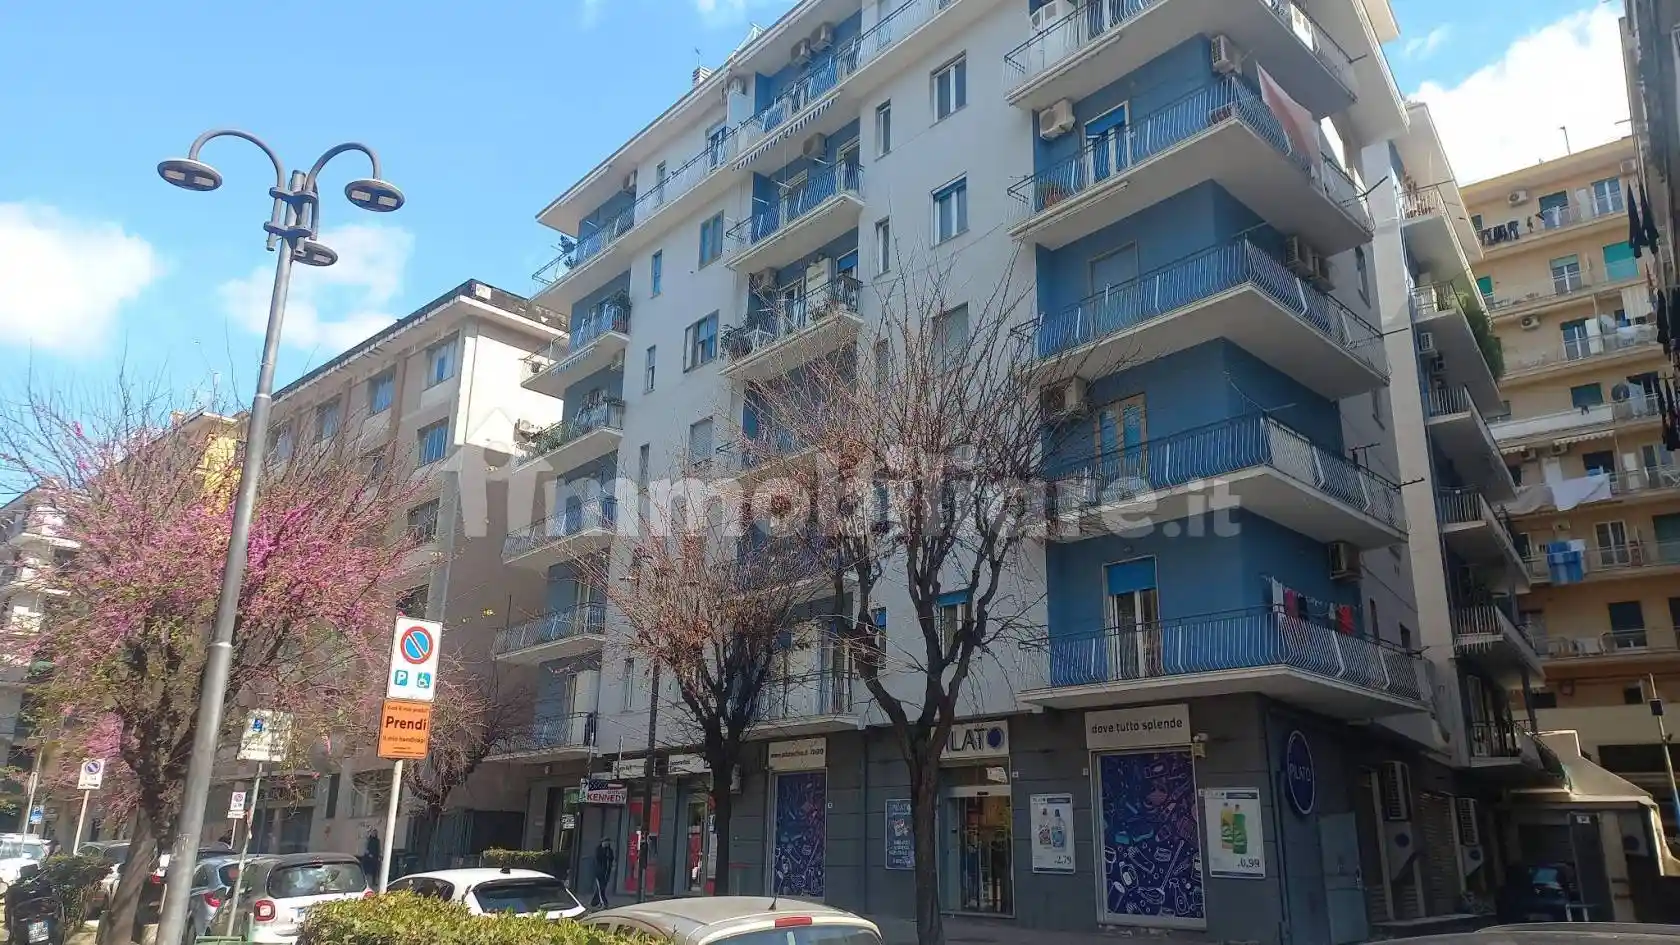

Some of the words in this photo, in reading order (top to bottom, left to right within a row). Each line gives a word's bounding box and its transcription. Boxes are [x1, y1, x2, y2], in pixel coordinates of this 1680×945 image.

[385, 715, 427, 731] Prendi
[1091, 724, 1114, 734] dove
[1116, 721, 1140, 733] tutto
[1142, 717, 1183, 731] splende
[945, 726, 1005, 752] ILATO
[588, 792, 627, 802] KENNEDY
